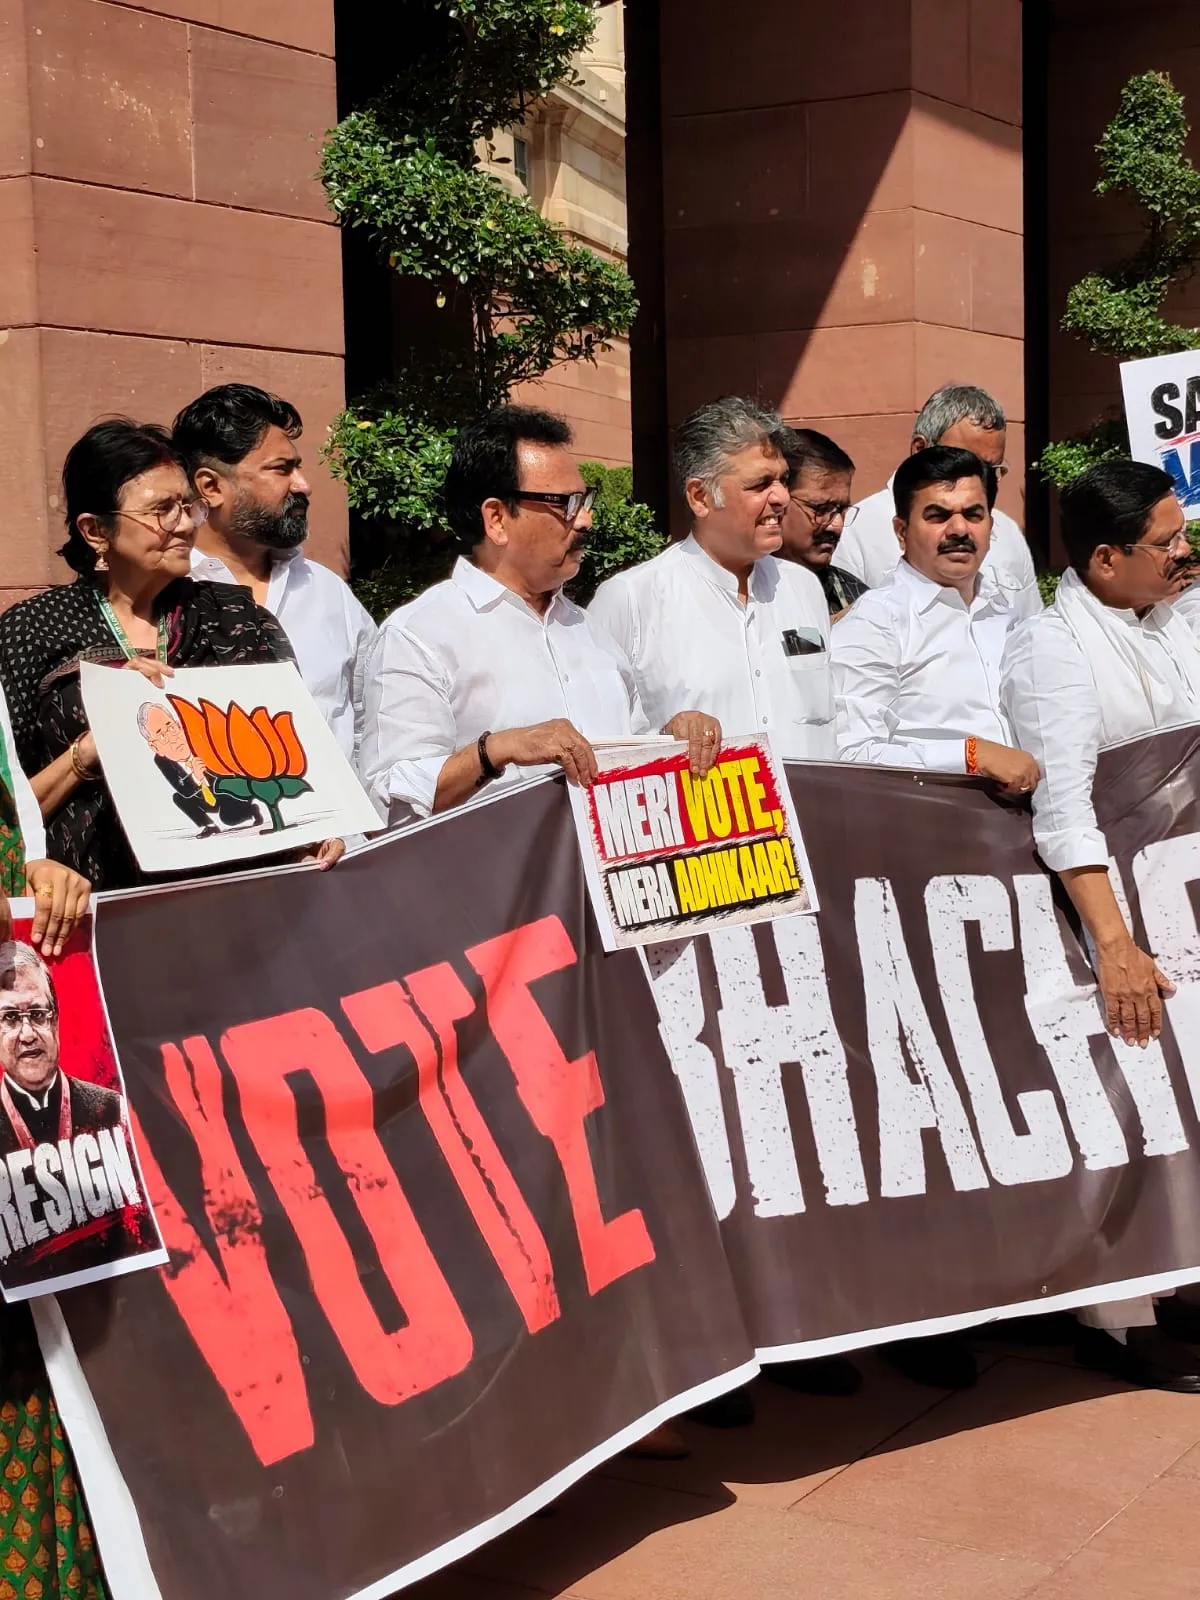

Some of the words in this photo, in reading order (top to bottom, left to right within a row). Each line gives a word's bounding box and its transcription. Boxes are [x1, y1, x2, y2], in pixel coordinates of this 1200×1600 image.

[593, 771, 685, 859] MERI
[680, 756, 785, 841] VOTE,
[607, 862, 680, 927] MERA
[674, 837, 801, 915] ADHIKAAR!
[129, 913, 656, 1467] VOTE
